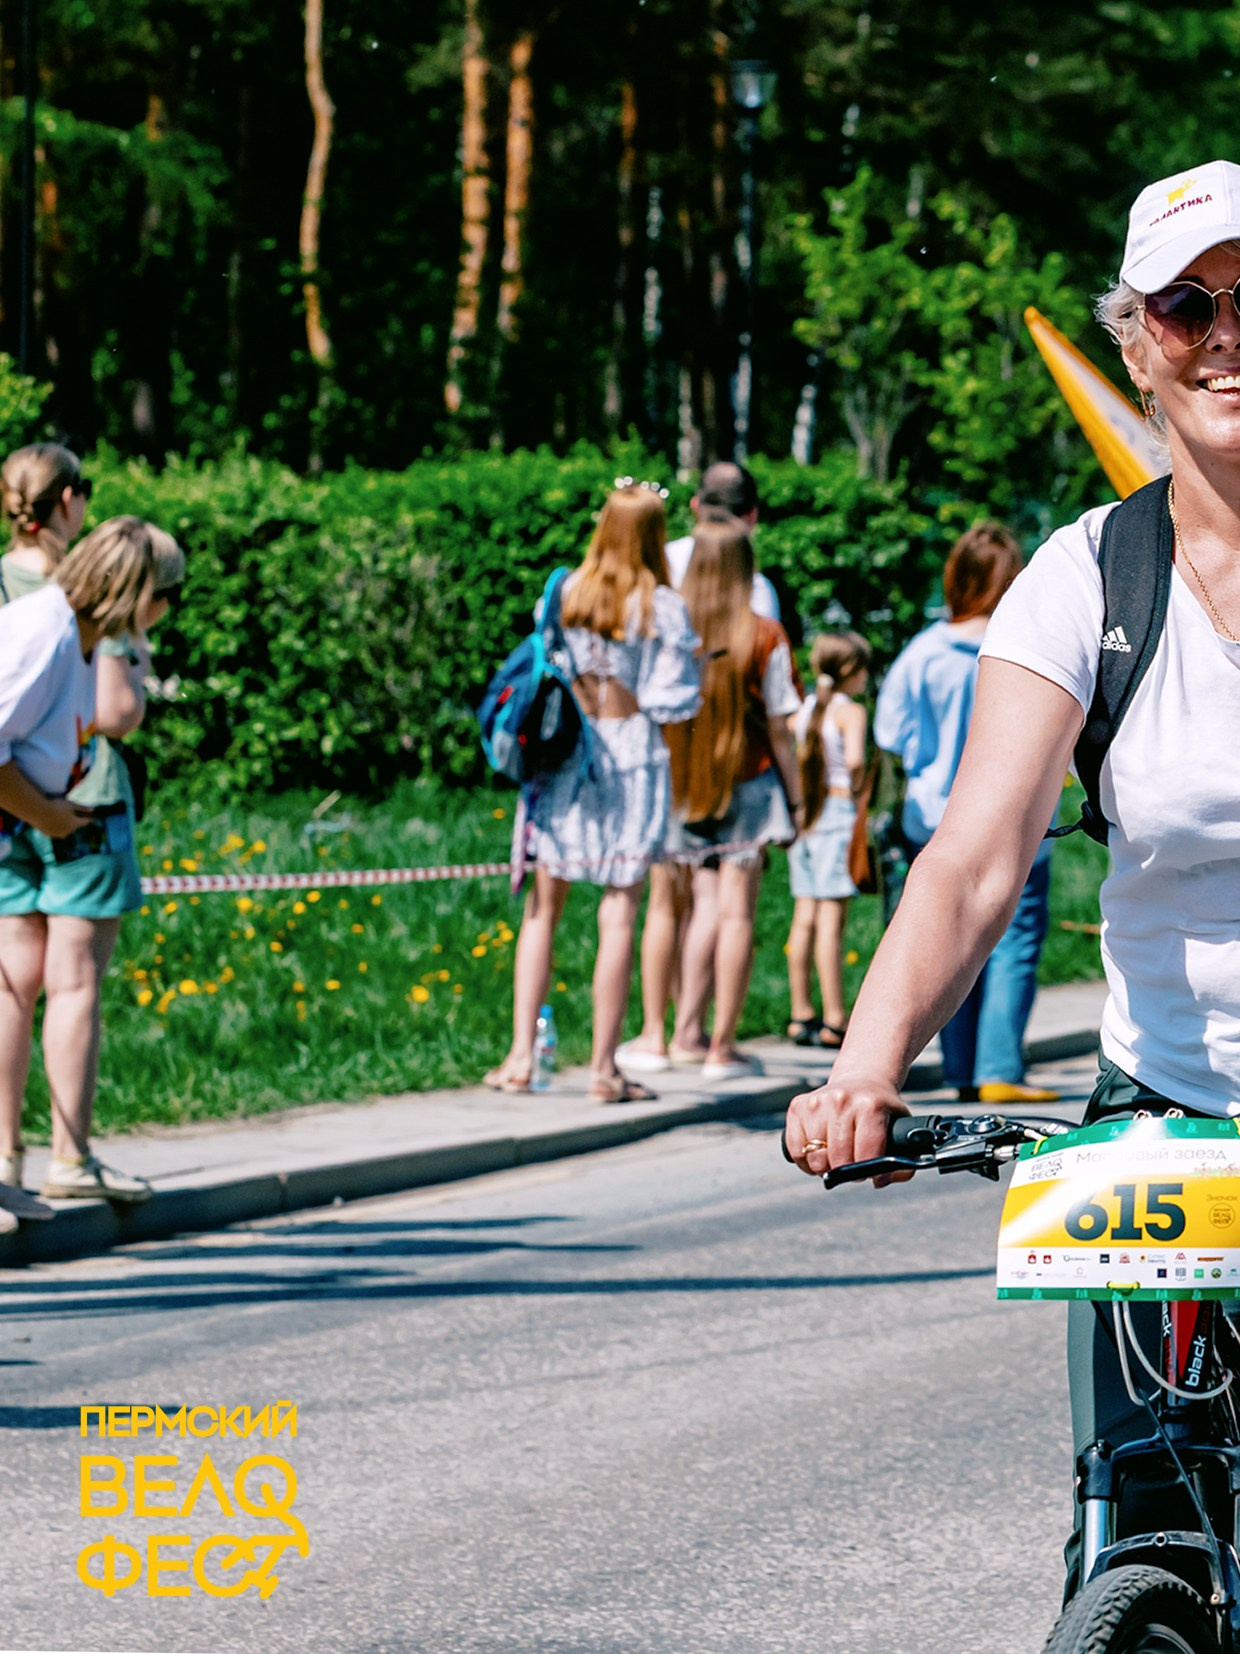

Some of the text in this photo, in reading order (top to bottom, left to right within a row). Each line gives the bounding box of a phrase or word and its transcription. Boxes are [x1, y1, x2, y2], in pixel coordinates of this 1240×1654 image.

[1102, 640, 1132, 653] adidas
[1174, 1149, 1227, 1161] заезд
[1064, 1183, 1186, 1242] 615
[1161, 1301, 1173, 1338] ack
[1185, 1335, 1207, 1387] black
